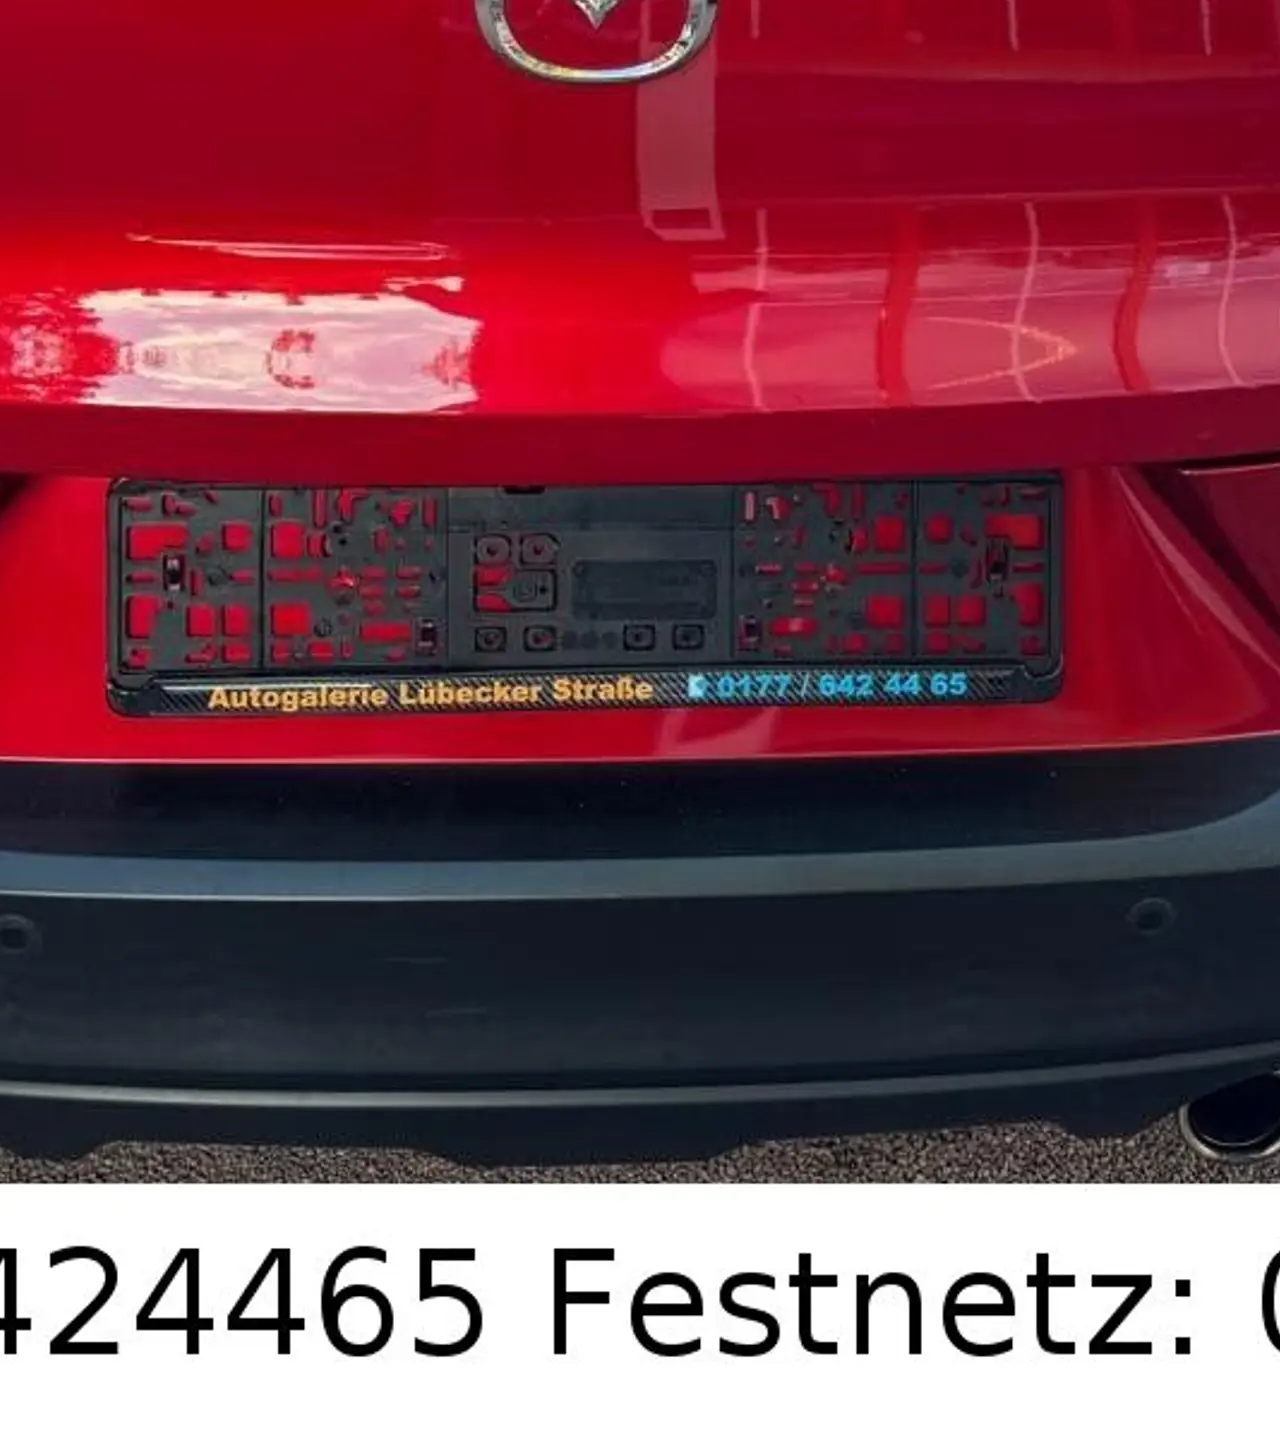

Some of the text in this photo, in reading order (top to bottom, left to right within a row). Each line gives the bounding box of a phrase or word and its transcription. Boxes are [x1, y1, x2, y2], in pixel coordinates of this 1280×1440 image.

[207, 675, 654, 712] Autogalerie Lübecker Straße
[717, 672, 792, 698] 0177
[819, 672, 874, 698] 642
[882, 671, 921, 696] 44
[929, 671, 968, 696] 65
